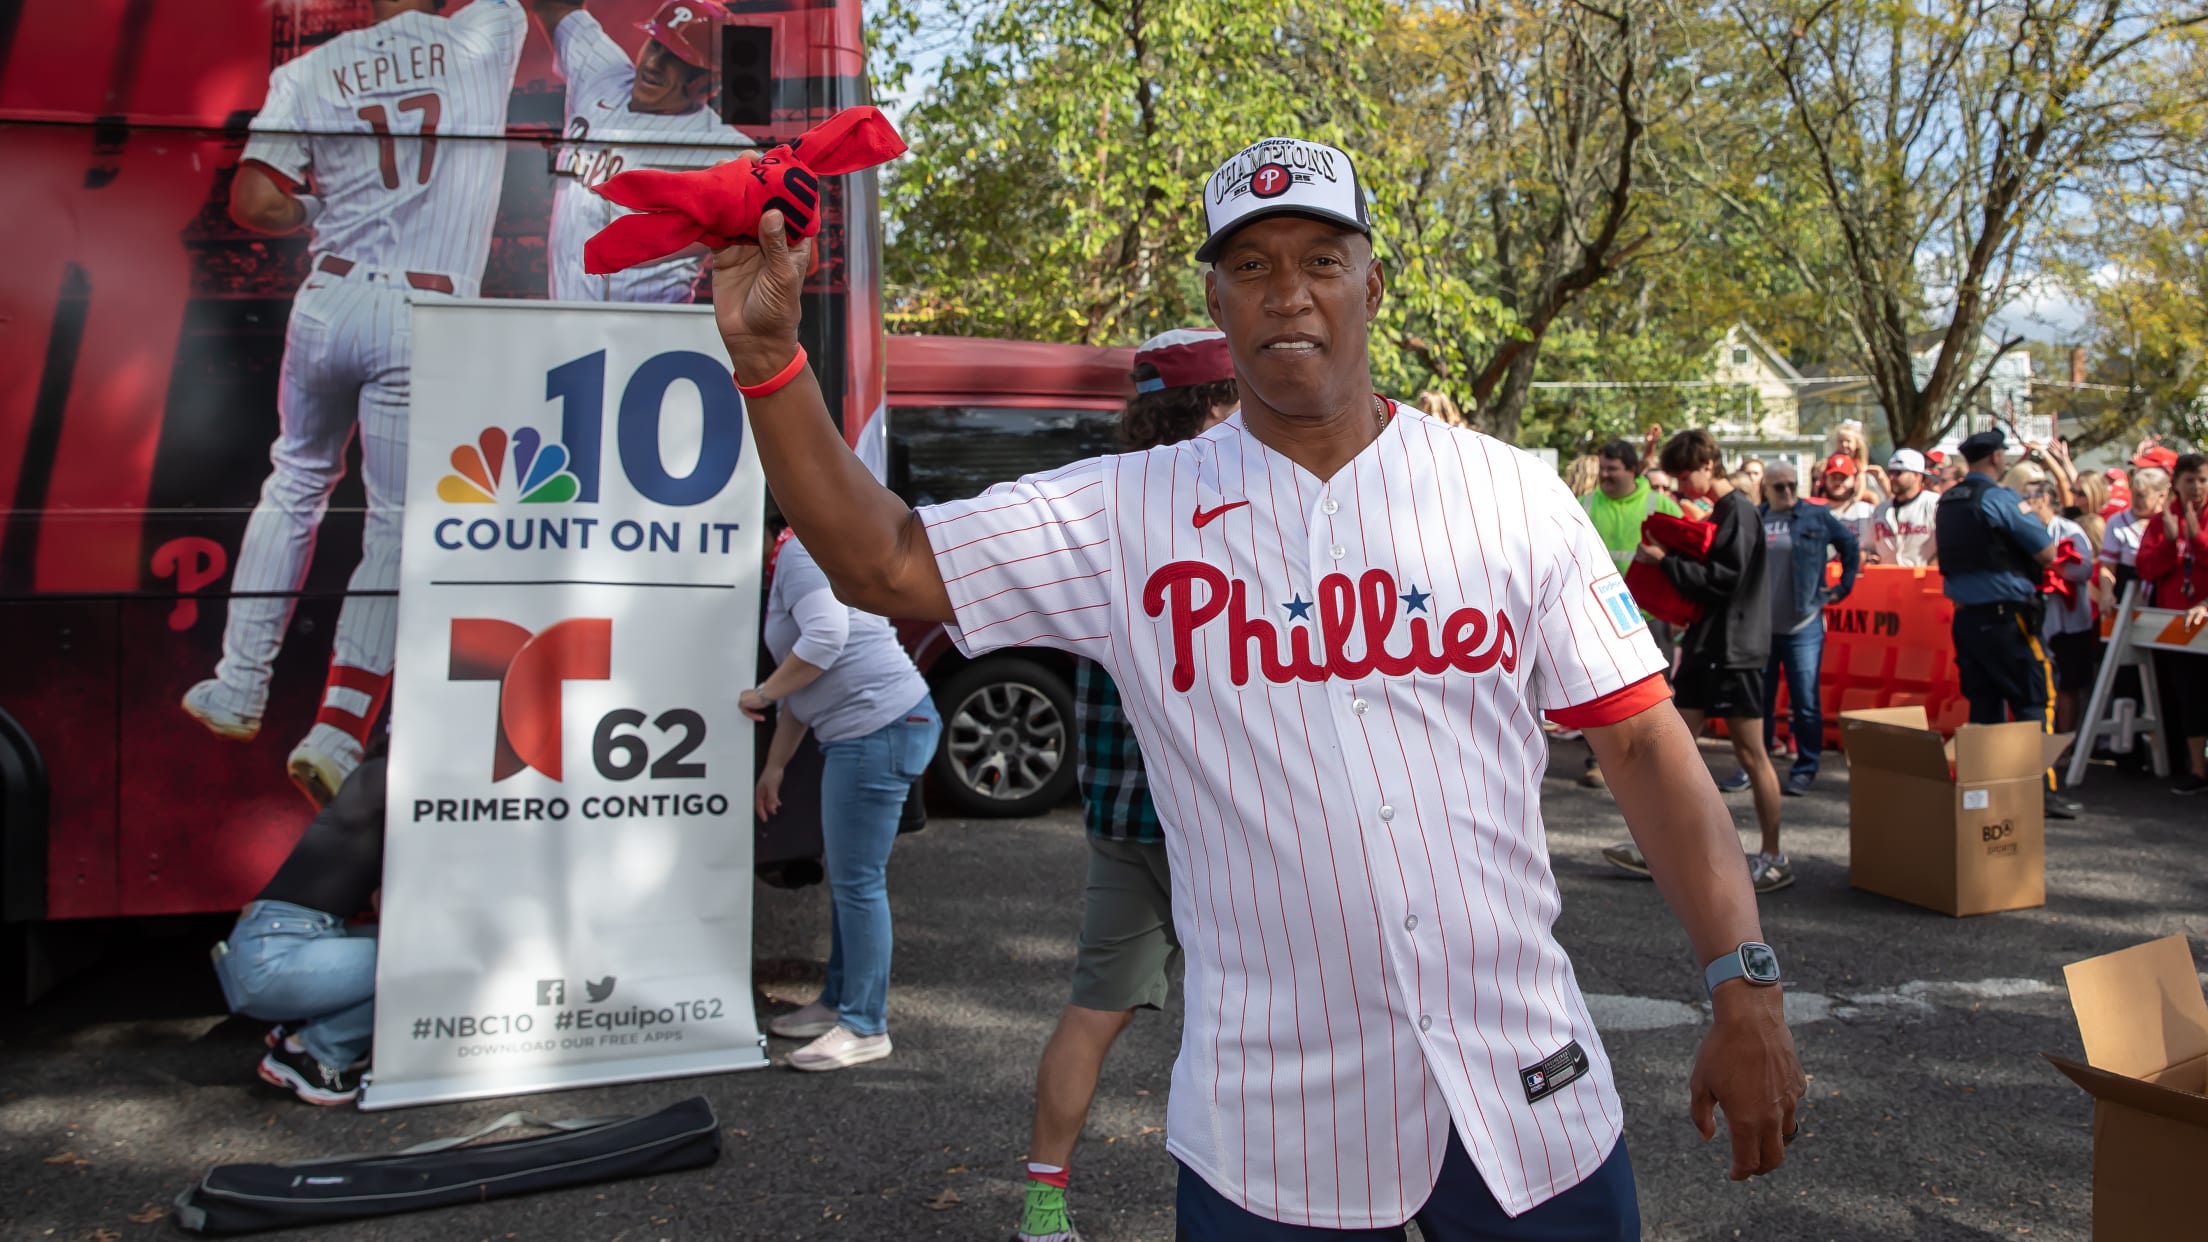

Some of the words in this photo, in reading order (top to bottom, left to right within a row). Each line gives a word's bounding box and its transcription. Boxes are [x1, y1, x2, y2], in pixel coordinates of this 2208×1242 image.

[333, 43, 446, 99] KEPLER
[357, 92, 441, 190] 17
[1240, 138, 1296, 157] DIVISION
[1213, 145, 1338, 206] CHAMPIONS
[545, 348, 744, 507] 10
[434, 517, 599, 551] COUNT
[610, 519, 681, 553] ON
[699, 522, 740, 555] IT
[1142, 559, 1518, 694] Phillies
[1872, 610, 1900, 637] PD
[592, 707, 707, 782] 62
[413, 797, 570, 823] PRIMERO
[581, 793, 729, 820] CONTIGO
[411, 1013, 534, 1041] #NBC10
[554, 997, 725, 1032] #EquipoT62
[457, 1039, 556, 1058] DOWNLOAD
[560, 1036, 595, 1050] OUR
[600, 1032, 640, 1047] FREE
[643, 1029, 684, 1043] APPS
